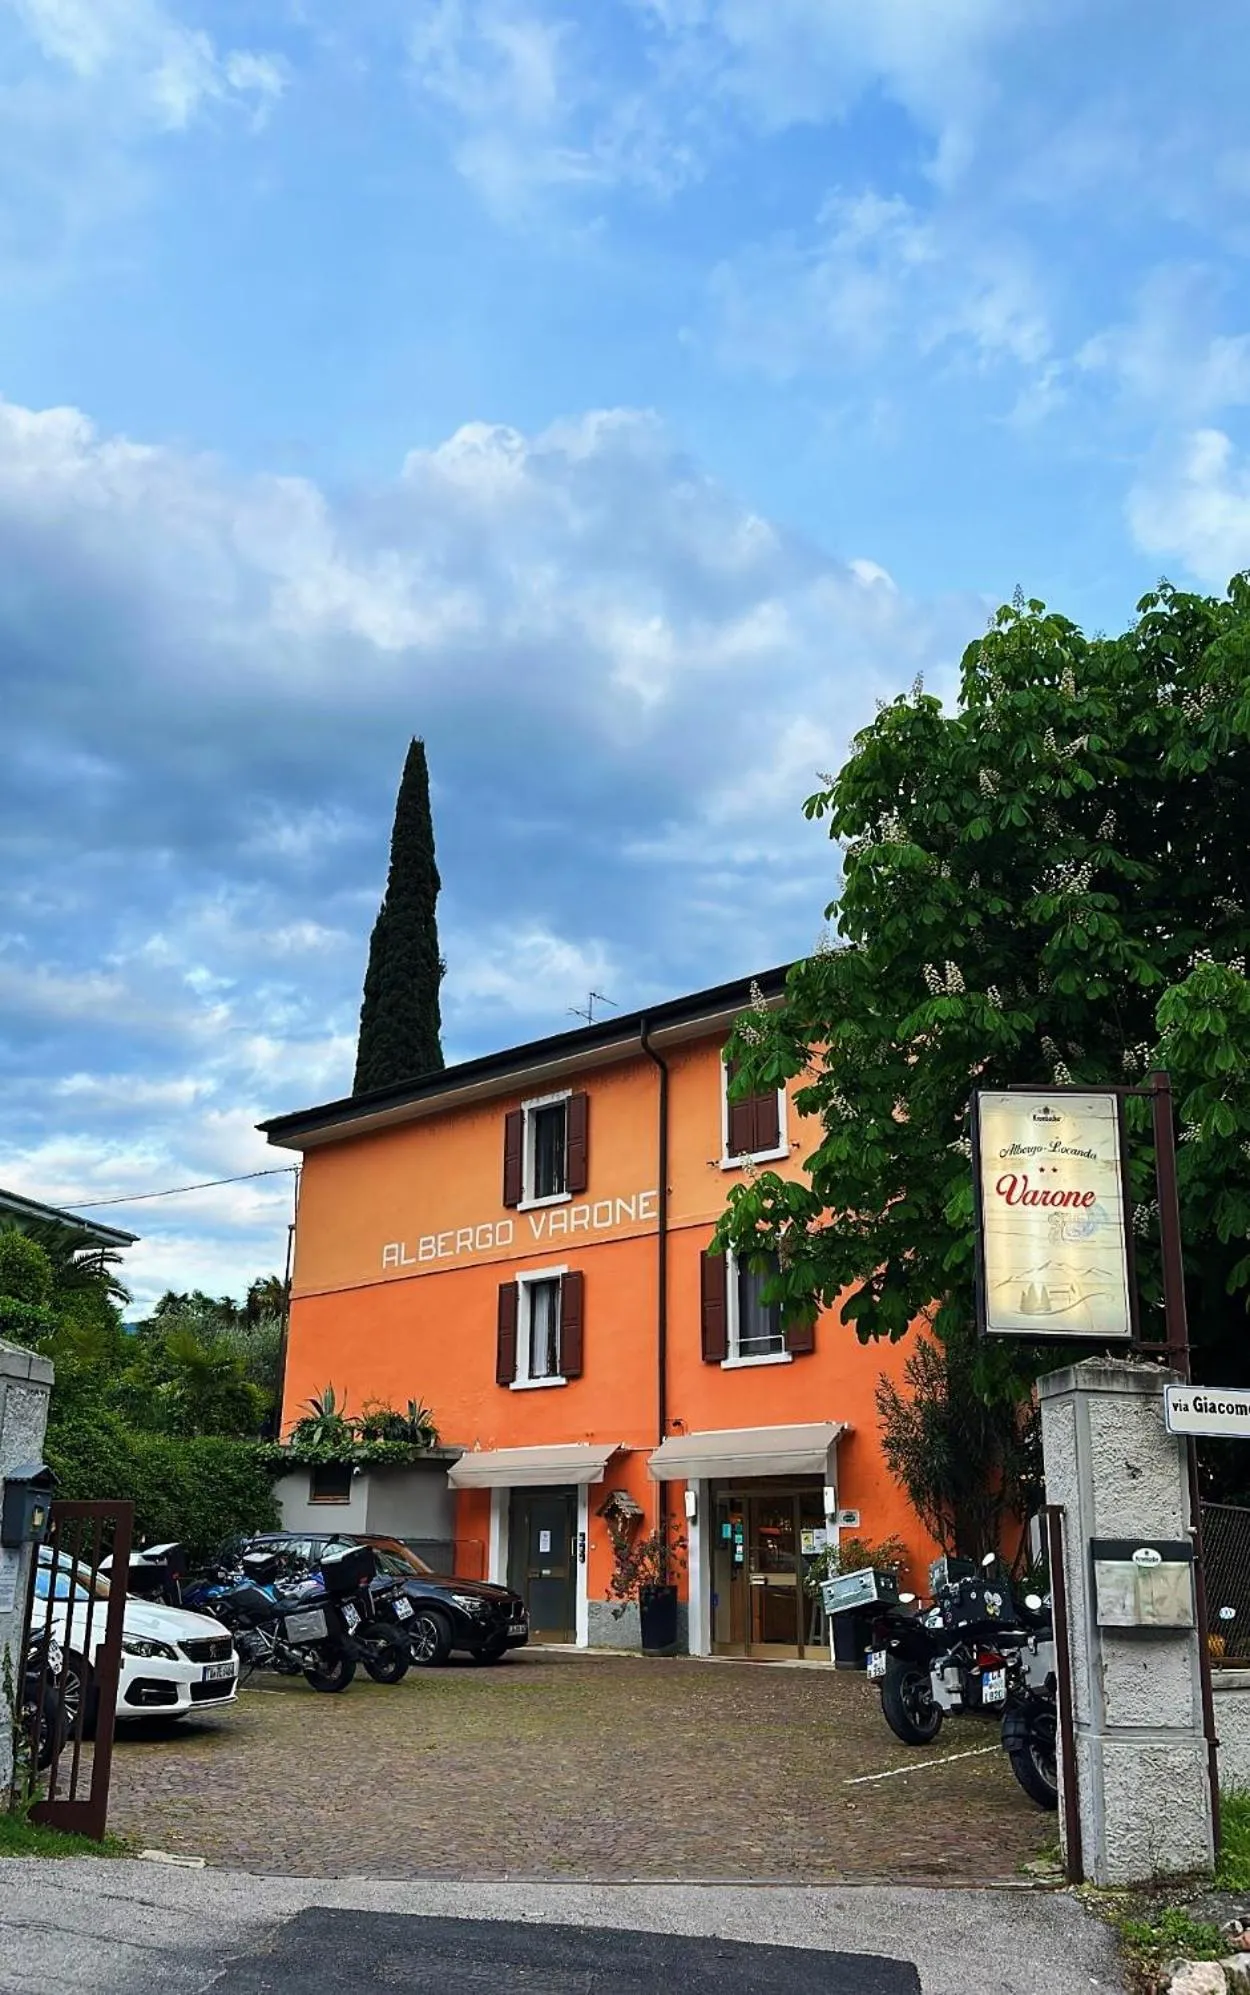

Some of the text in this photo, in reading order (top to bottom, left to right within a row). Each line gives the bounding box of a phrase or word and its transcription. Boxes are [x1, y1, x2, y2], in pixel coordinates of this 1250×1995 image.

[995, 1173, 1097, 1208] Varone
[382, 1190, 658, 1269] ALBERGO VARONE
[1172, 1395, 1250, 1416] via Giacom
